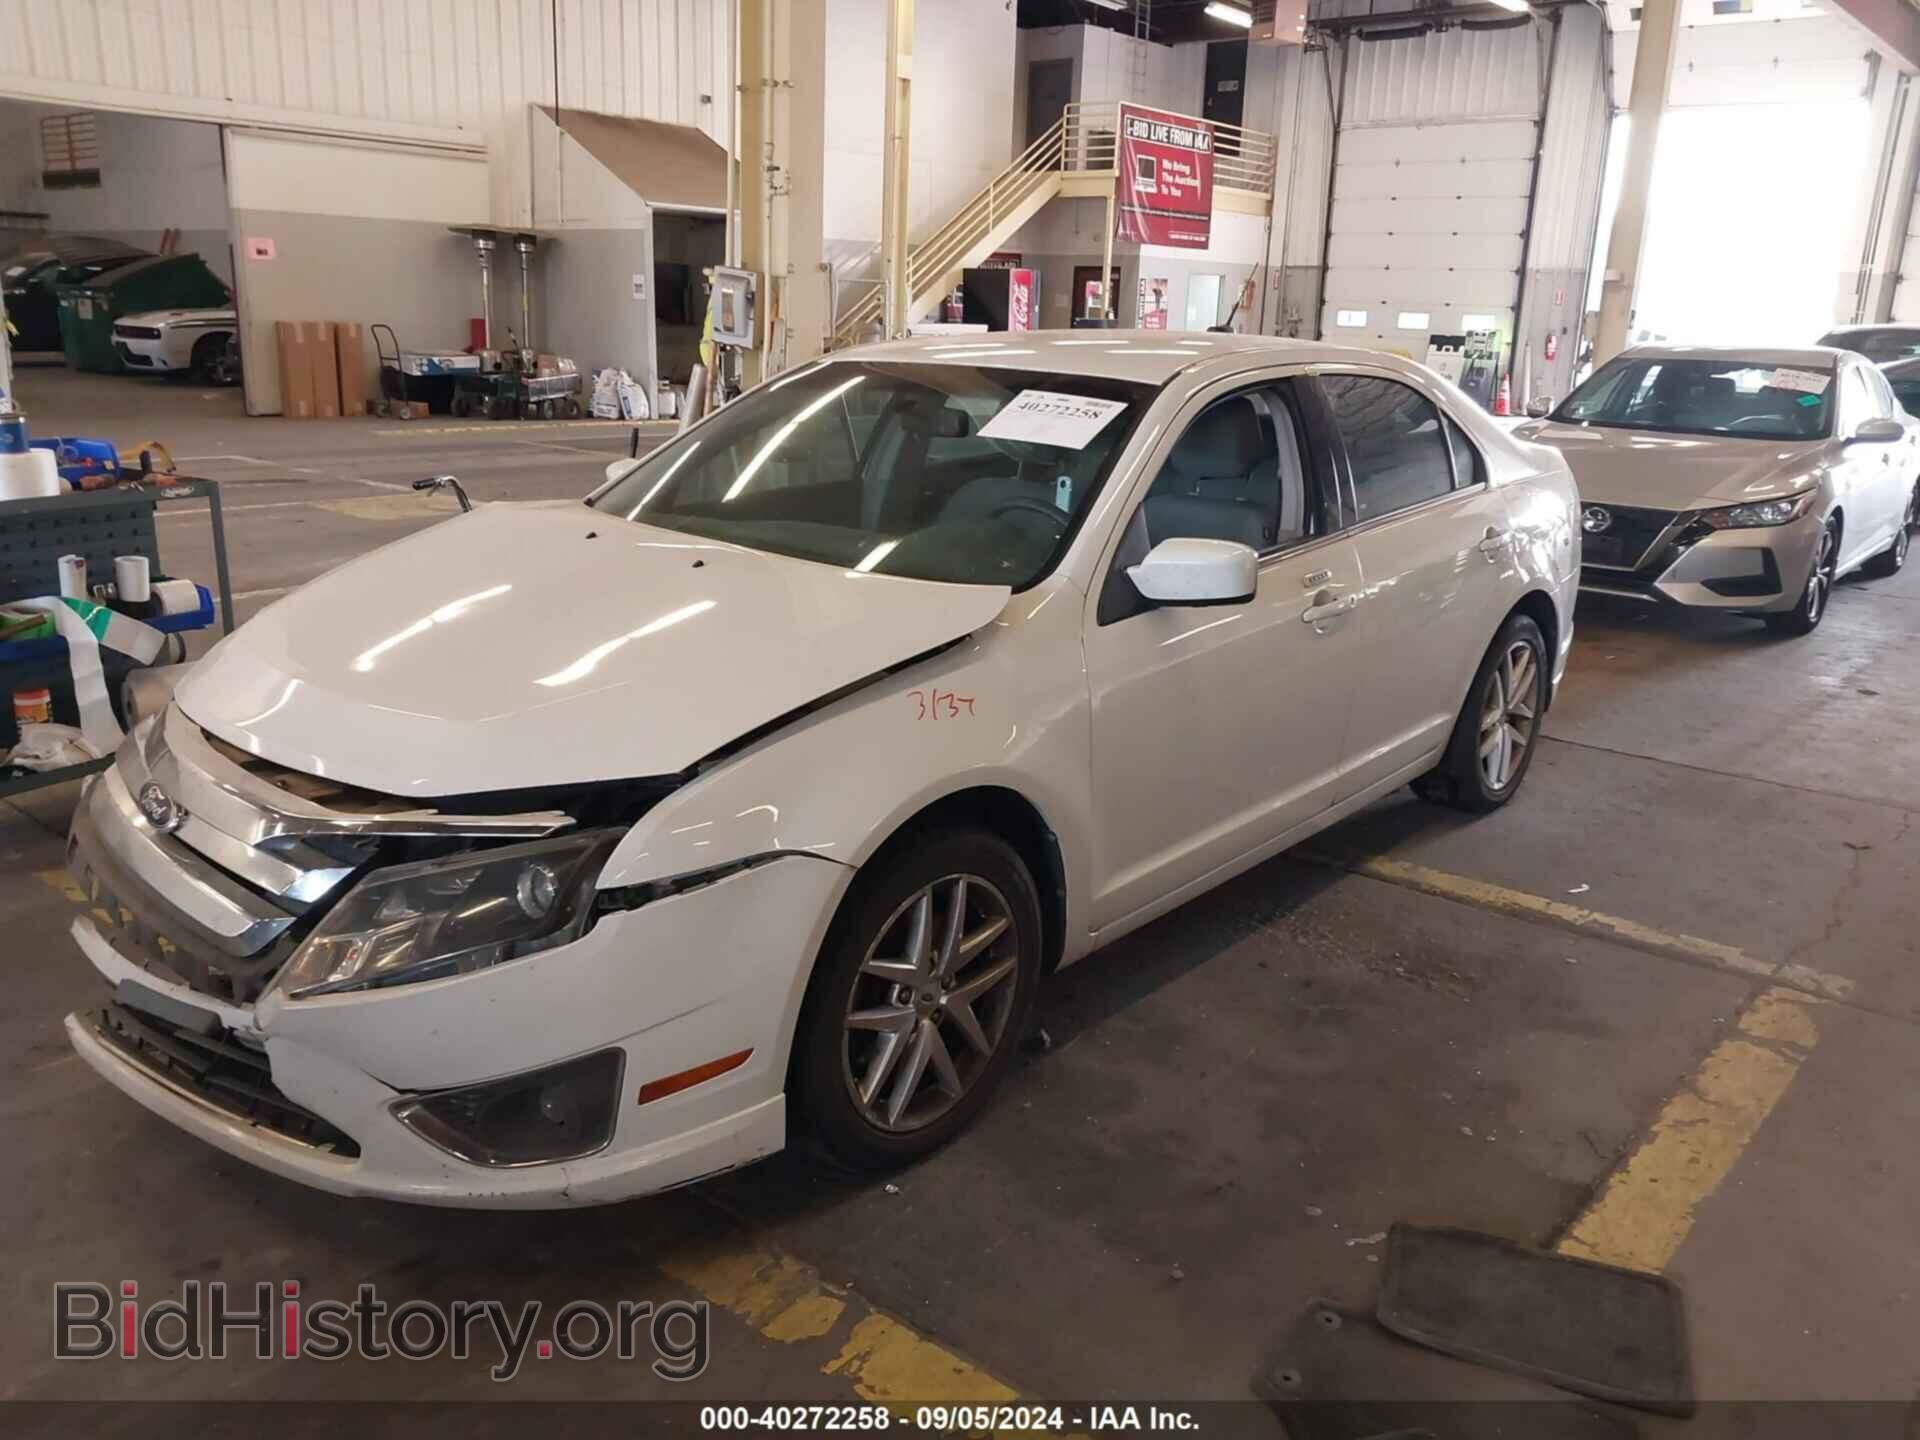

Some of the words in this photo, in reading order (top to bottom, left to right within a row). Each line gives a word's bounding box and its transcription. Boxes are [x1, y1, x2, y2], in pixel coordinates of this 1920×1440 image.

[1150, 122, 1169, 142] LIVE
[1169, 127, 1193, 148] FROM
[1018, 401, 1103, 419] 40272258
